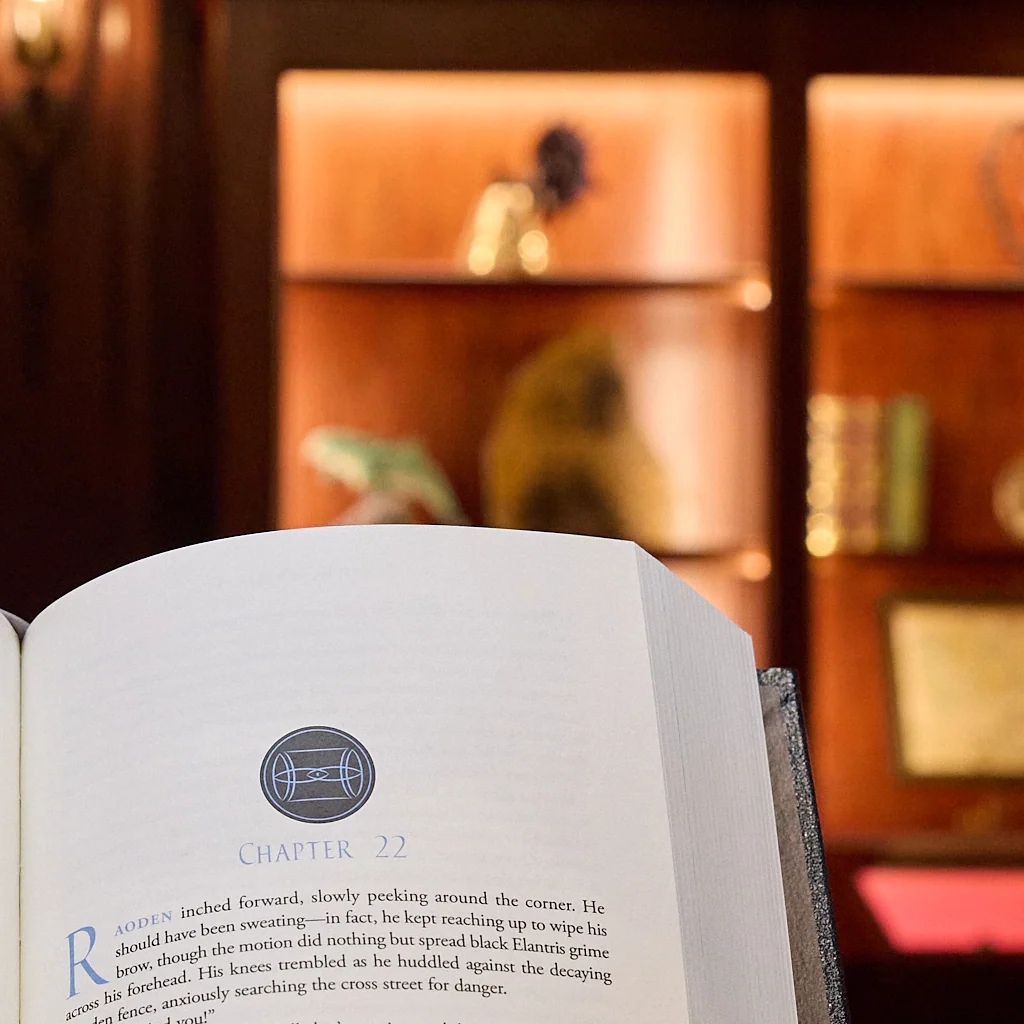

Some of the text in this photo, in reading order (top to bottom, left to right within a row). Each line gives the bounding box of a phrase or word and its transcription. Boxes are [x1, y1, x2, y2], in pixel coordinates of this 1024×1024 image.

[239, 835, 407, 865] CHAPTER 22
[181, 897, 232, 919] inched
[238, 890, 304, 909] forward,
[311, 888, 360, 906] slowly
[367, 888, 429, 907] peeking
[434, 891, 489, 905] around
[495, 892, 519, 907] the
[525, 899, 575, 912] corner.
[582, 899, 605, 915] He
